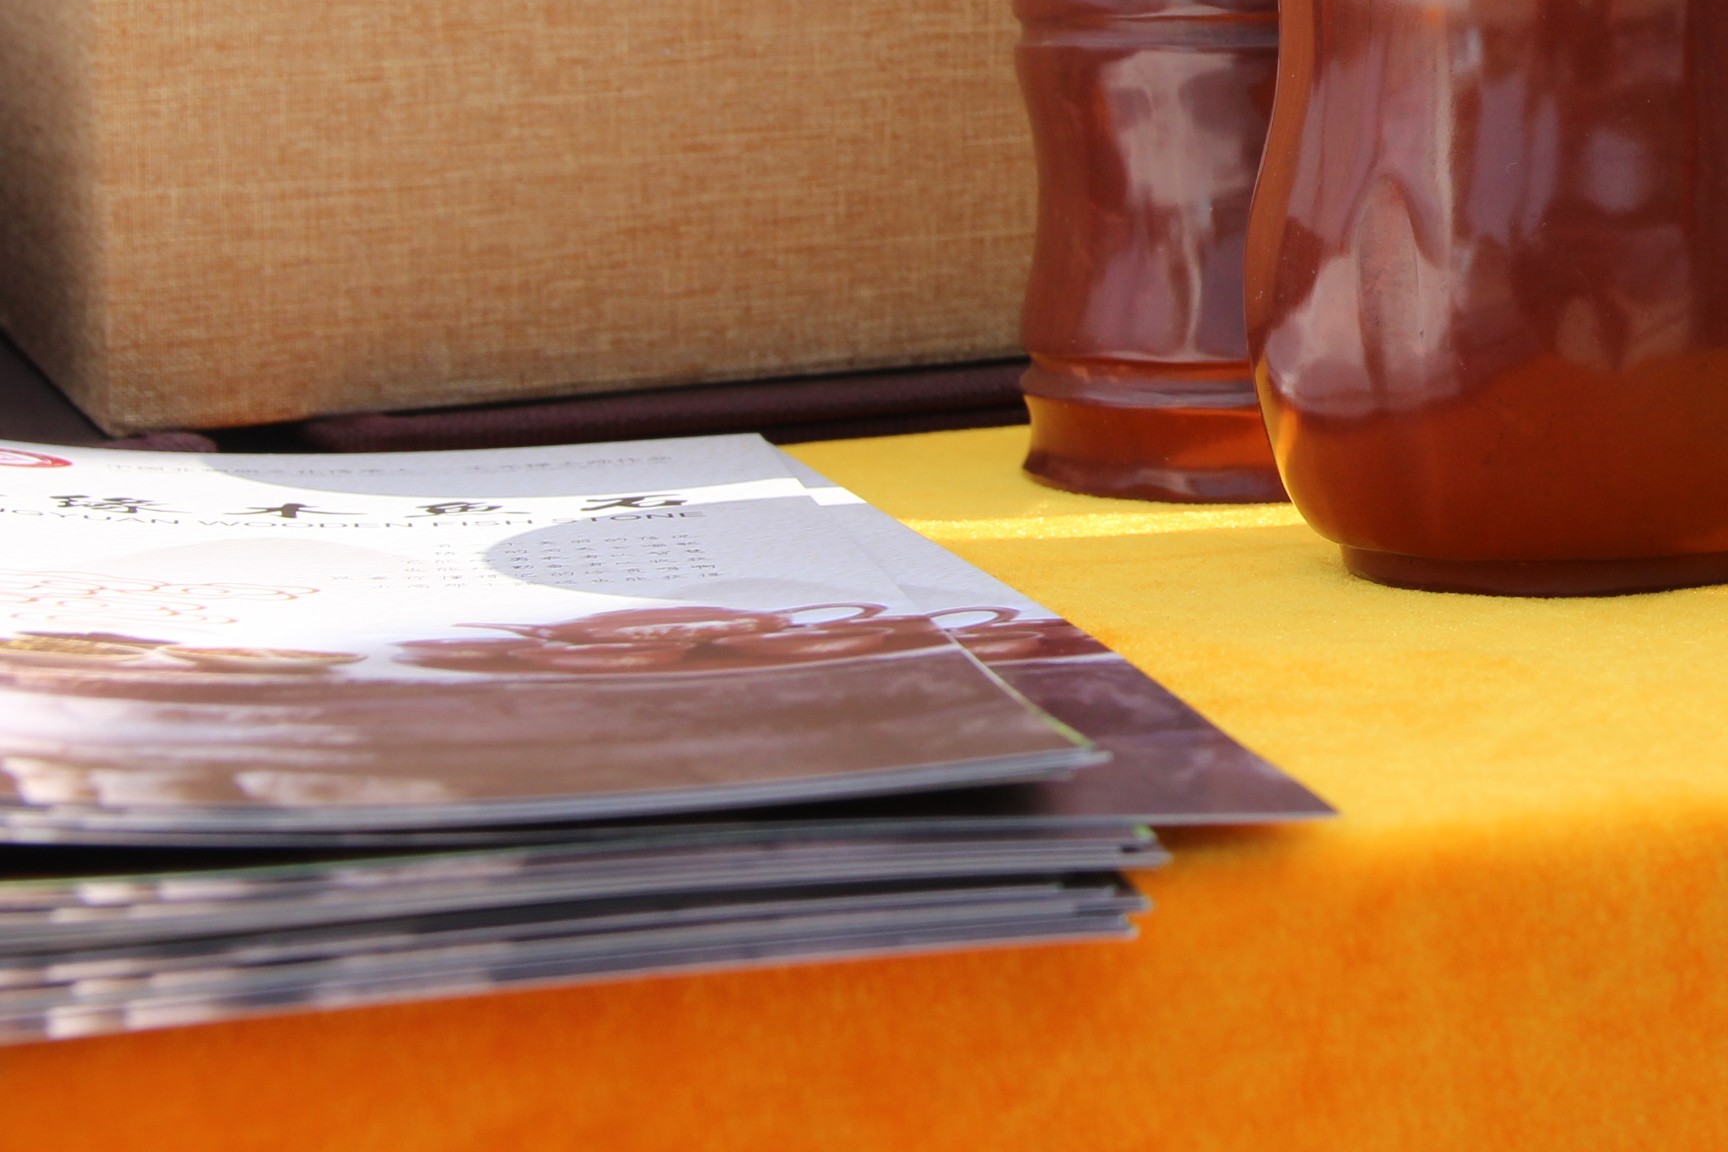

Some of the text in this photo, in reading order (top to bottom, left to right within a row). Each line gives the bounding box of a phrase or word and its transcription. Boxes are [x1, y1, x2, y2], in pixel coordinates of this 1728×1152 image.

[198, 520, 413, 528] WOODEN
[433, 519, 533, 527] FISH
[552, 511, 706, 524] STONE
